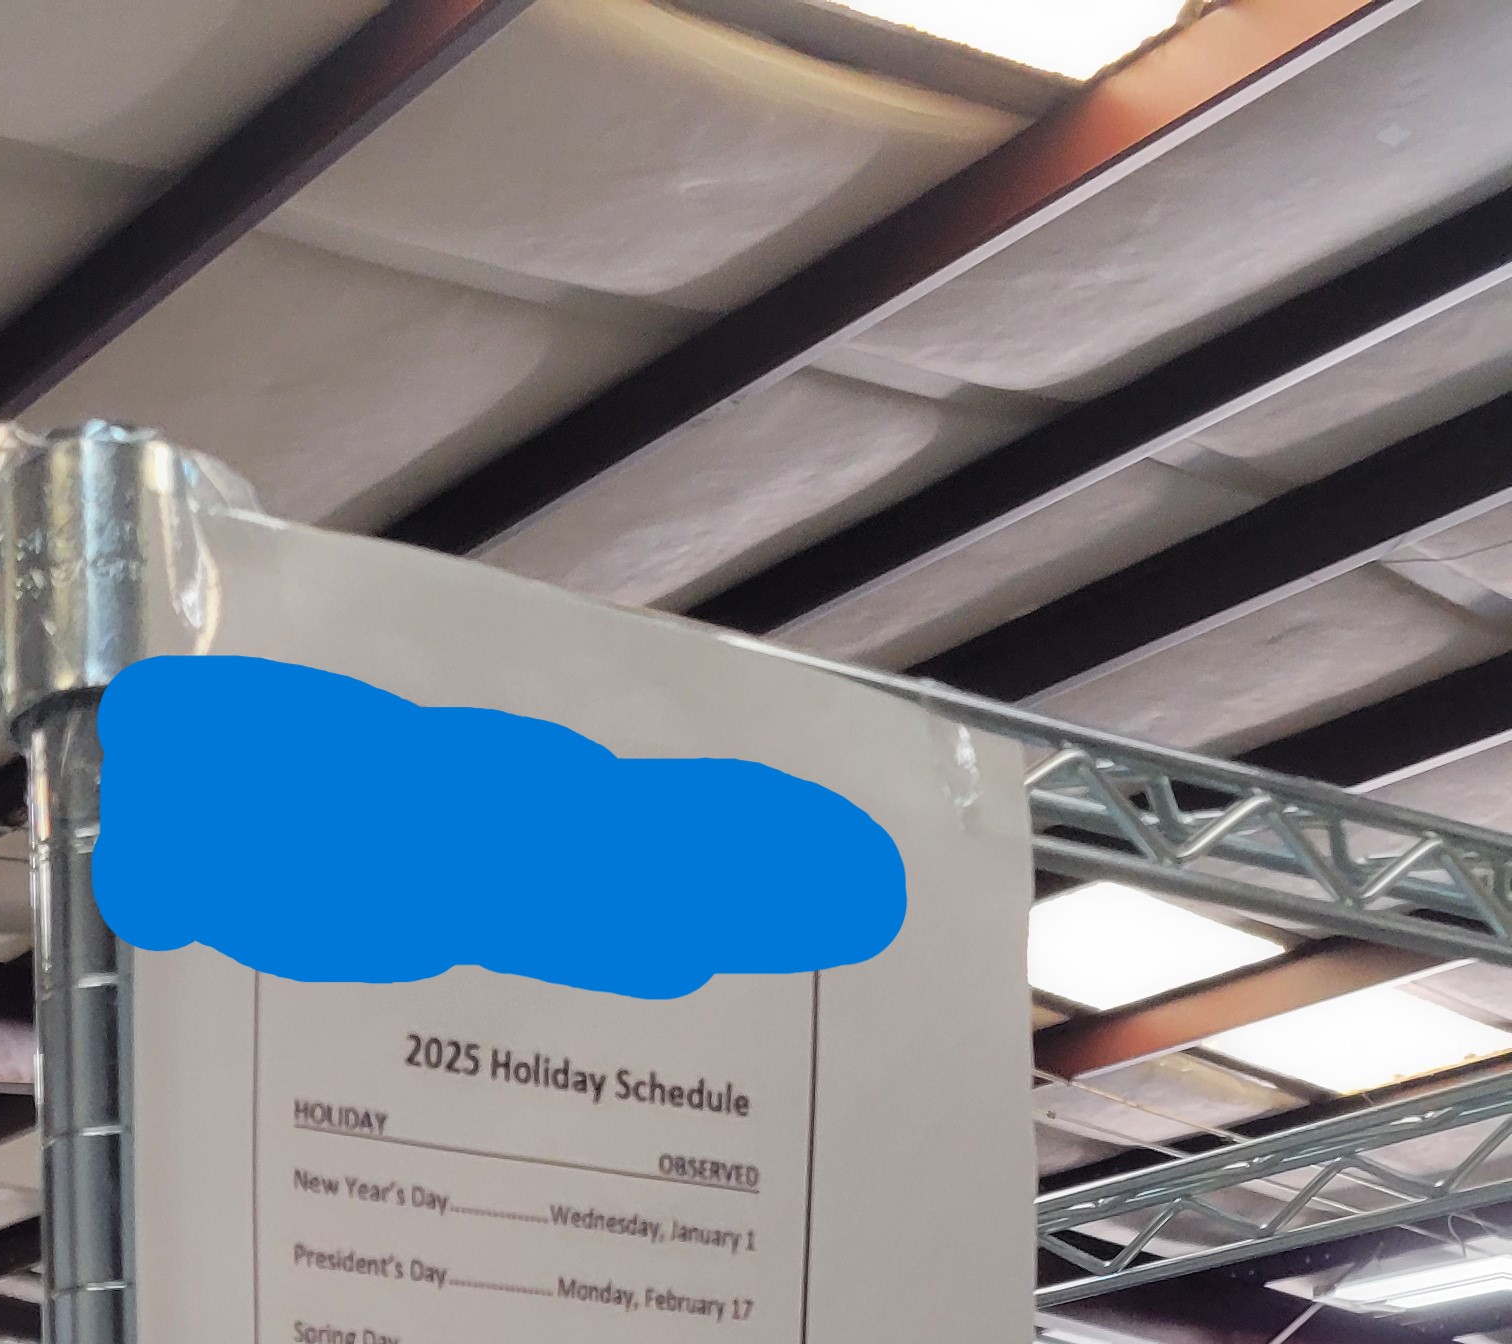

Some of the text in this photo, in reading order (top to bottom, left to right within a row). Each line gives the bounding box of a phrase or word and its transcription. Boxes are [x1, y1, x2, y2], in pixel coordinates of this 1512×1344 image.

[405, 1033, 750, 1117] 2025 Holiday Schedule
[294, 1101, 760, 1188] HOLIDAY OBSERVED
[294, 1169, 339, 1195] New
[411, 1185, 449, 1216] Day
[550, 1205, 665, 1244] Wednesday,
[671, 1220, 742, 1254] January
[745, 1231, 756, 1252] 1
[294, 1243, 753, 1323] President's Day Monday, February 17
